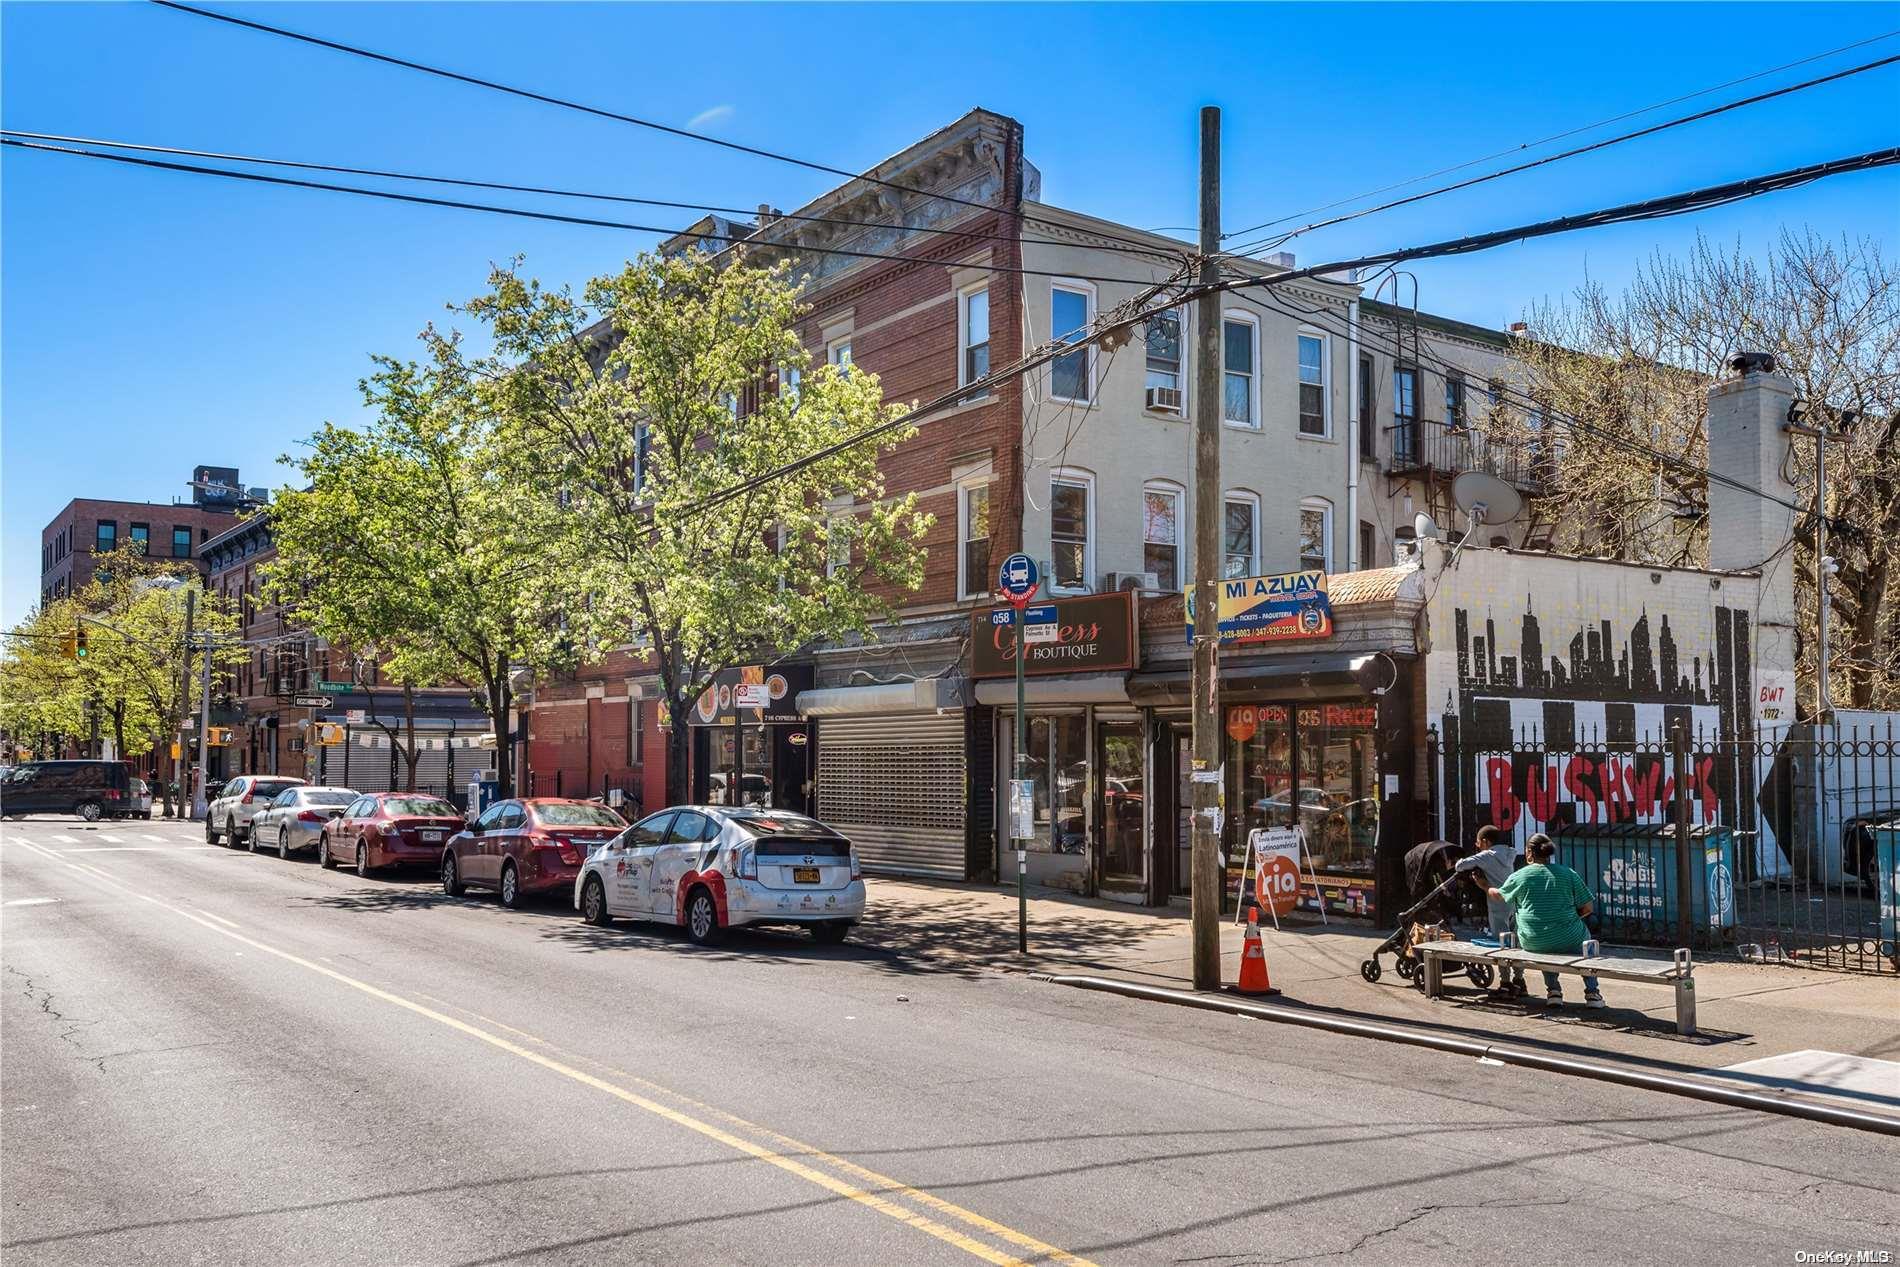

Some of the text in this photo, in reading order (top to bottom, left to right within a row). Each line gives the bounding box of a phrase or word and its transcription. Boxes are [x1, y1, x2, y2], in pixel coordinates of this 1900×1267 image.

[1003, 586, 1036, 600] NO STANDING
[1226, 574, 1321, 599] MI AZUAY
[992, 612, 1010, 624] Q58
[1240, 614, 1258, 622] TICKETS
[1262, 611, 1293, 619] PAQUETERIA
[1033, 643, 1098, 659] BOUTIQUE
[1760, 686, 1785, 702] BWT
[1258, 707, 1288, 722] OPEN
[1259, 842, 1297, 852] Latinoamérica
[1263, 863, 1296, 895] ria
